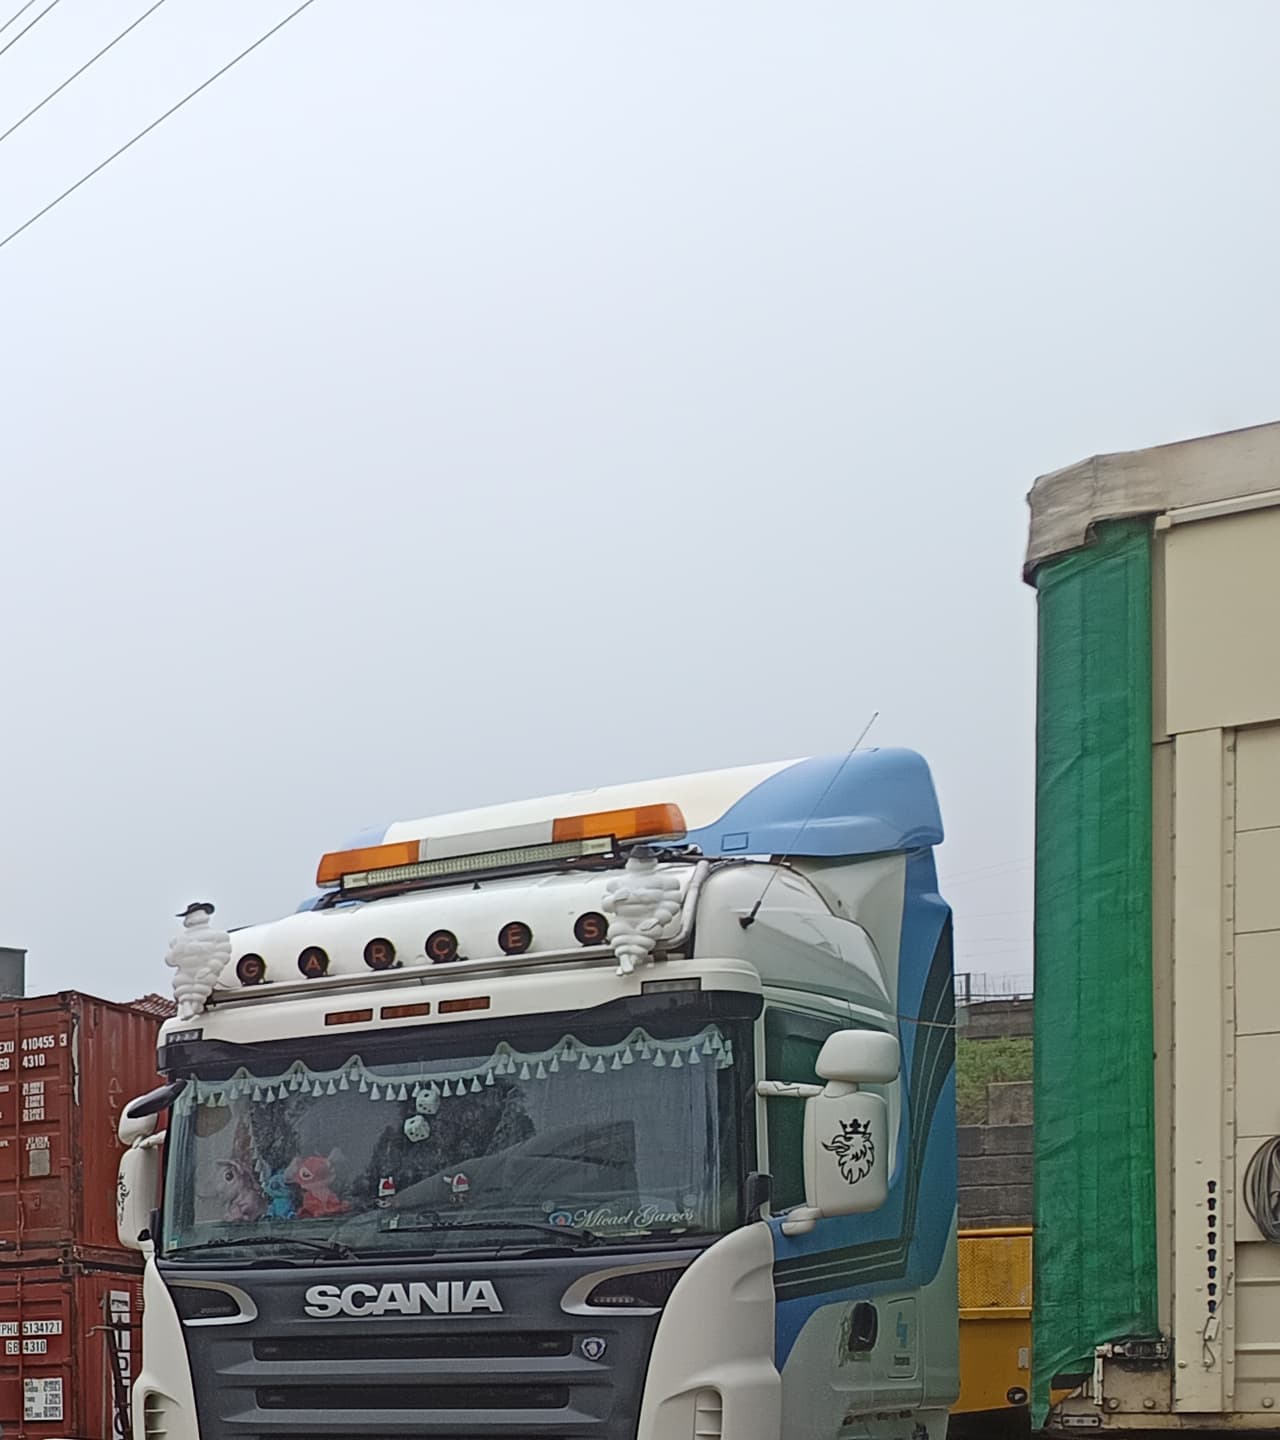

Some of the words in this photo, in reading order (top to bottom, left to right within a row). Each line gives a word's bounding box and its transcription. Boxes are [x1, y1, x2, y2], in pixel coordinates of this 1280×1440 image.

[21, 1035, 54, 1051] 410455
[22, 1054, 46, 1069] 4310
[304, 1280, 504, 1318] SCANIA
[23, 1322, 60, 1334] 5134121
[23, 1340, 46, 1353] 4310
